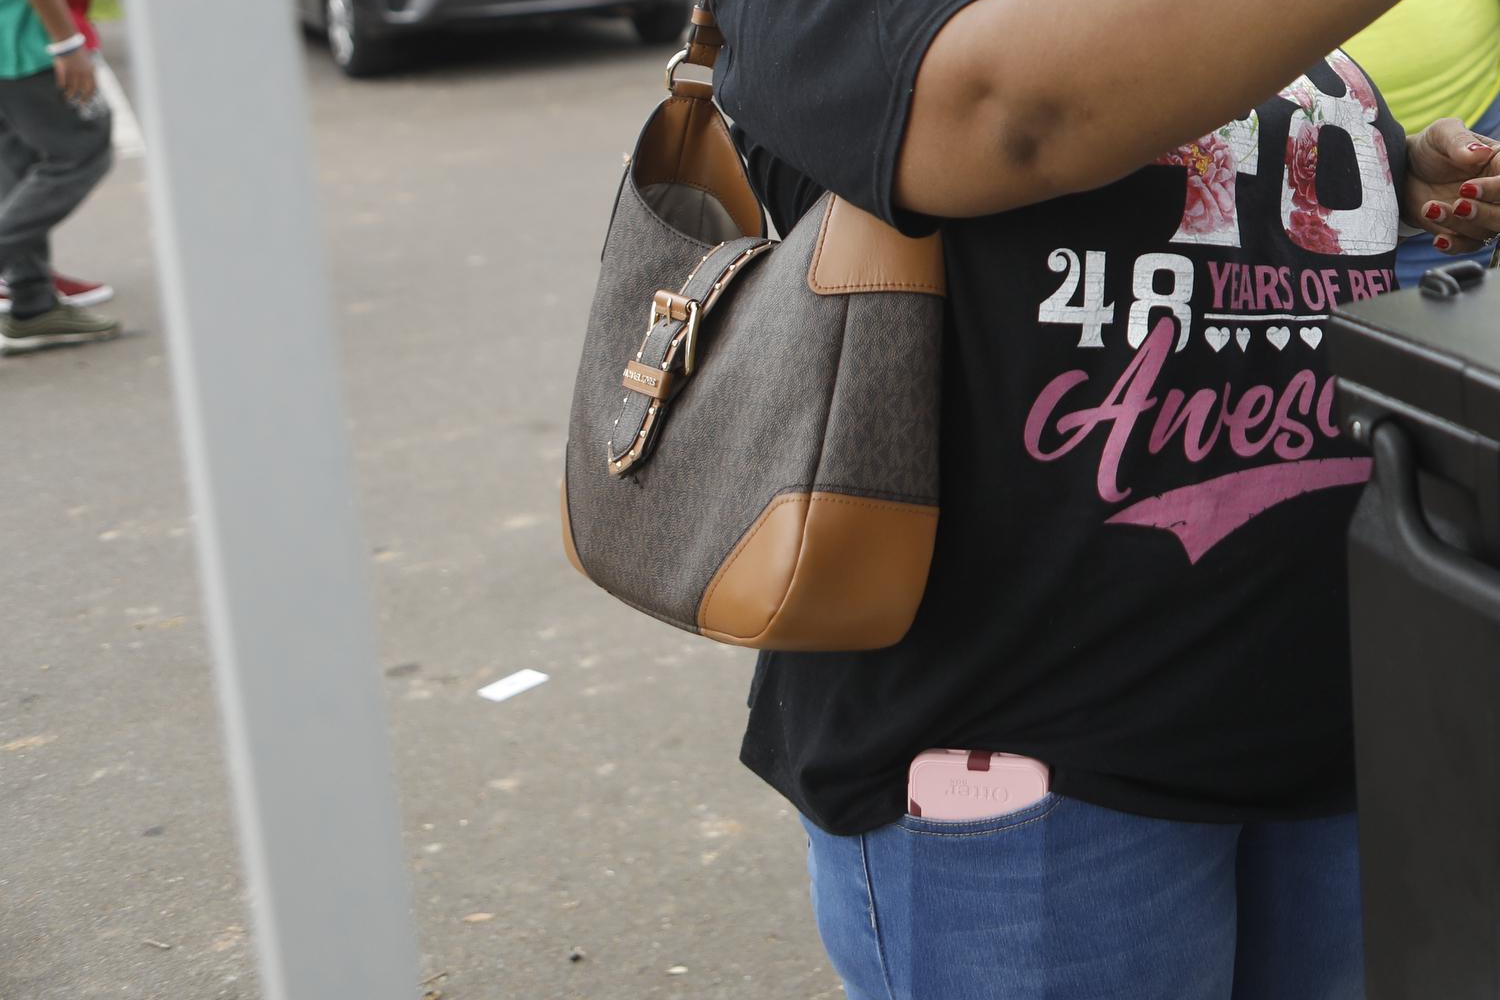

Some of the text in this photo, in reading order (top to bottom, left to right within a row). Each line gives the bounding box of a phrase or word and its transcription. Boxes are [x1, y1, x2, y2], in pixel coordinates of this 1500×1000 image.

[1038, 247, 1195, 353] 48
[1207, 261, 1294, 310] YEARS
[1301, 269, 1340, 312] OF
